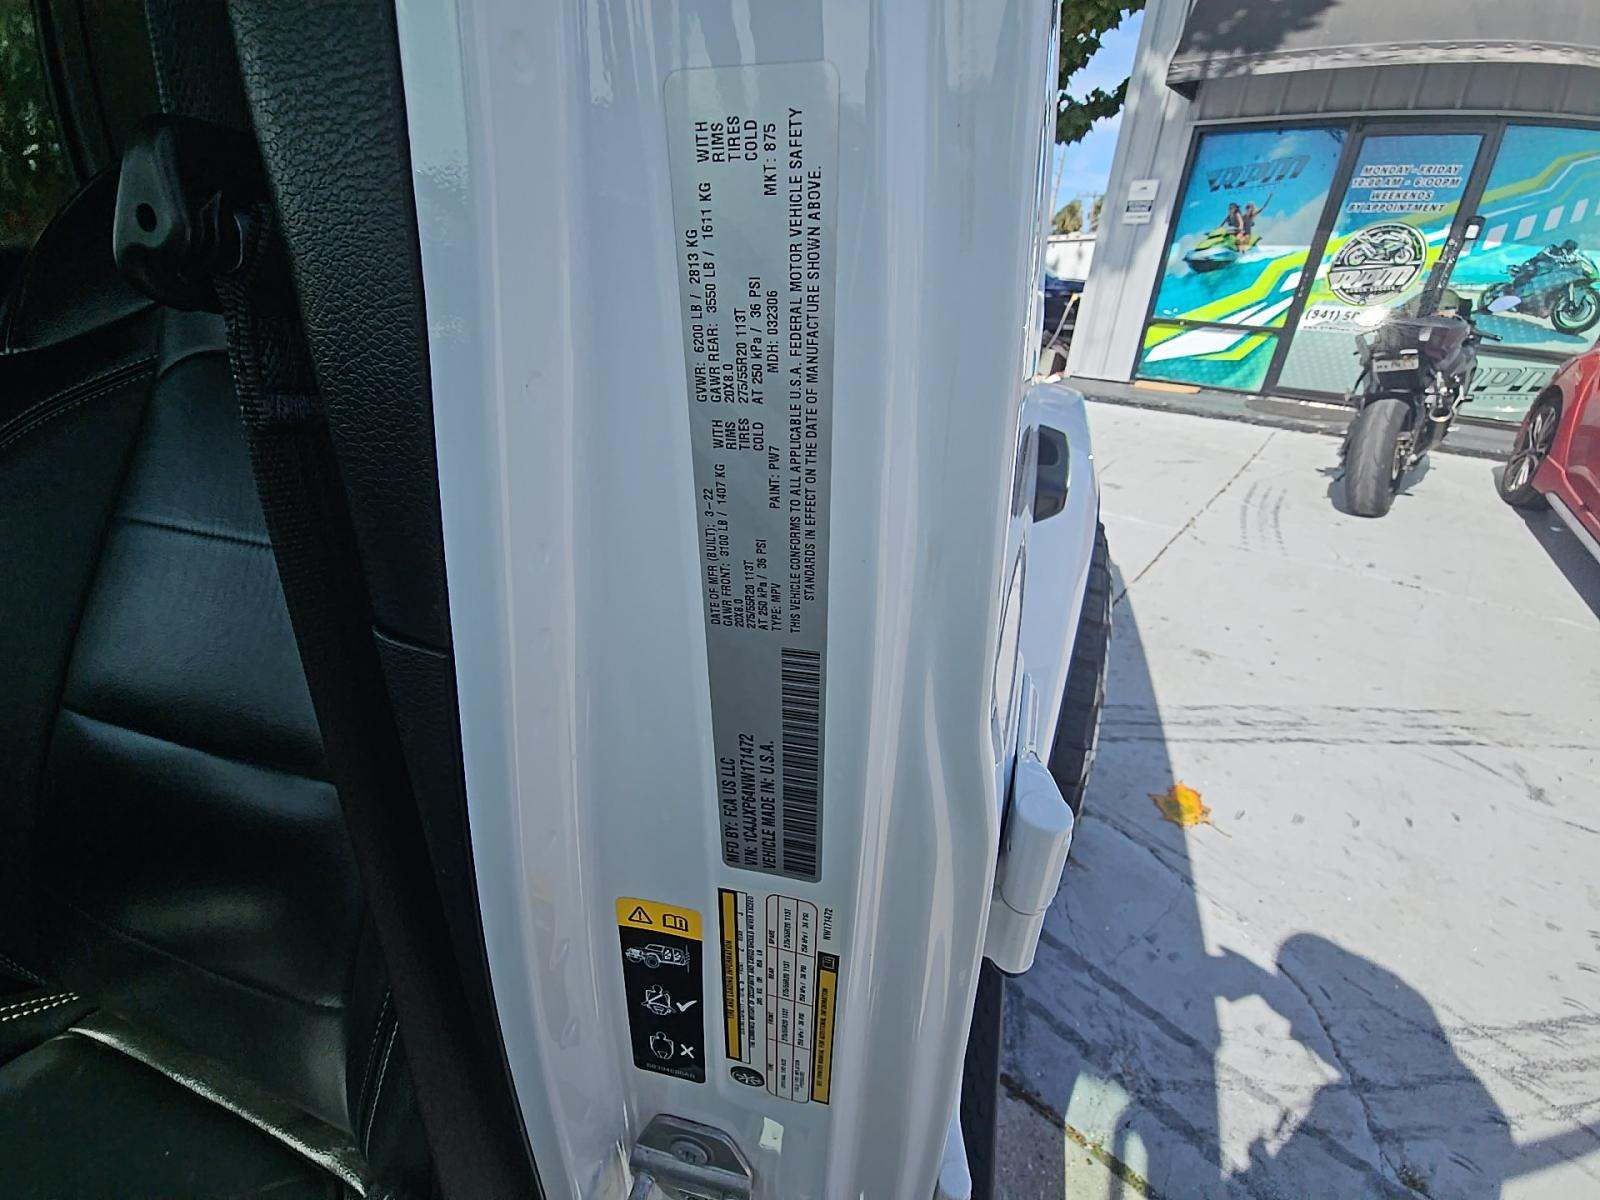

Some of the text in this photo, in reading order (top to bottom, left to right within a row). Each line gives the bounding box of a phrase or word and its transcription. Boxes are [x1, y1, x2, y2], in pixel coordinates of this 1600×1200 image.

[695, 122, 709, 162] WITH
[711, 123, 724, 162] RIMS
[727, 116, 741, 162] TIRES
[744, 120, 757, 161] COLD
[764, 124, 776, 196] MKT: 875
[699, 182, 711, 201] KG
[1370, 190, 1433, 201] WEEKENDS
[1363, 203, 1446, 213] APPOINTMENT
[686, 230, 698, 247] KG
[701, 210, 713, 239] 1611
[688, 253, 700, 284] 2813
[704, 262, 715, 277] LB
[705, 284, 717, 312] 3550
[749, 277, 761, 297] PSI
[691, 304, 702, 318] LB
[749, 304, 761, 318] 36
[692, 325, 704, 352] 6200
[707, 324, 719, 361] REAR:
[767, 291, 778, 373] MDH: 032306
[734, 308, 748, 403] 275/55R20 113T
[750, 338, 762, 359] kPa
[694, 362, 707, 402] GVWR:
[709, 366, 721, 402] GAWR
[723, 364, 734, 403] 20X8.0
[751, 364, 762, 384] 250
[789, 108, 802, 633] THIS VEHICLE CONFORMS TO ALL APPLICABLE U.S.A. FEDERAL MOTOR VEHICLE SAFETY
[805, 166, 821, 600] STANDARDS IN EFFECT ON THE DATE OF MANUFACTURE SHOWN ABOVE.
[752, 389, 763, 404] AT
[712, 420, 723, 449] WITH
[725, 421, 736, 450] RIMS
[738, 418, 749, 450] TIRES
[753, 422, 763, 451] COLD
[715, 464, 725, 477] KG
[769, 446, 780, 508] PAINT: PW7
[716, 482, 726, 504] 1407
[718, 520, 727, 531] LB
[703, 488, 720, 624] DATE OF MFR (BUILT): 3-22
[719, 535, 729, 556] 3100
[756, 540, 766, 554] PSI
[756, 558, 766, 568] 36
[720, 563, 731, 596] FRONT:
[757, 582, 767, 597] kPa
[743, 560, 756, 629] 275/55R20 113T
[758, 601, 768, 616] 250
[771, 583, 781, 631] TYPE: MPV
[722, 600, 732, 626] GAWR
[733, 599, 743, 627] 20X8.0
[758, 619, 768, 630] AT
[720, 758, 740, 863] MFD BY: FCA US LLC
[739, 734, 757, 865] VIN: 1C4JJXP64NW171472
[760, 741, 776, 869] VEHICLE MADE IN: U.S.A.
